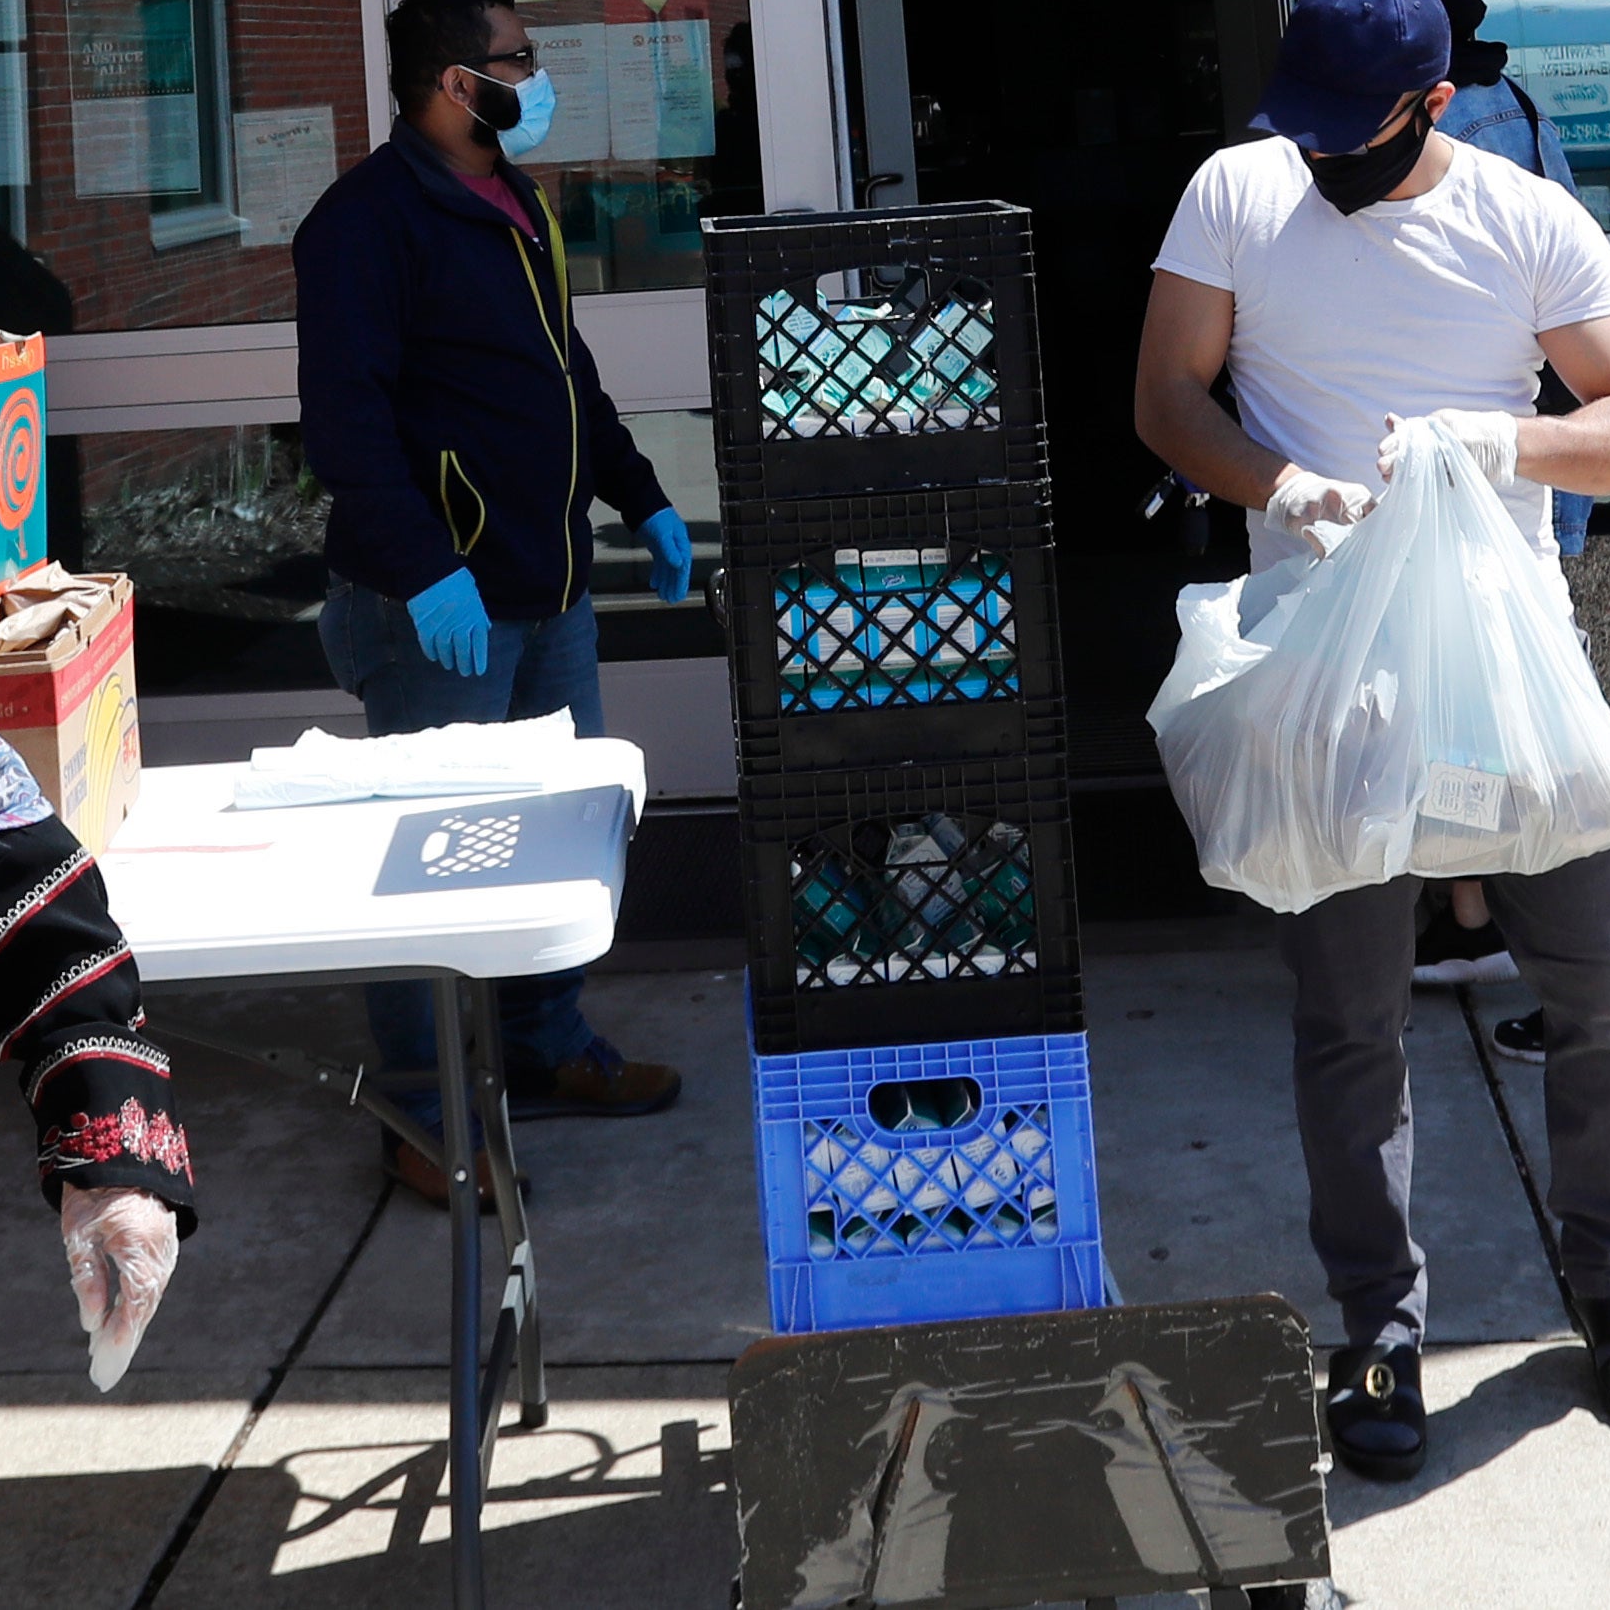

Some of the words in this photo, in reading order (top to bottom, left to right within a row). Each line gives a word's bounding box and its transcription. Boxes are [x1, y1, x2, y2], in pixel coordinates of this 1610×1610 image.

[82, 42, 113, 54] AND
[543, 38, 583, 50] ACCESS
[82, 51, 144, 65] JUSTICE
[99, 64, 127, 76] ALL
